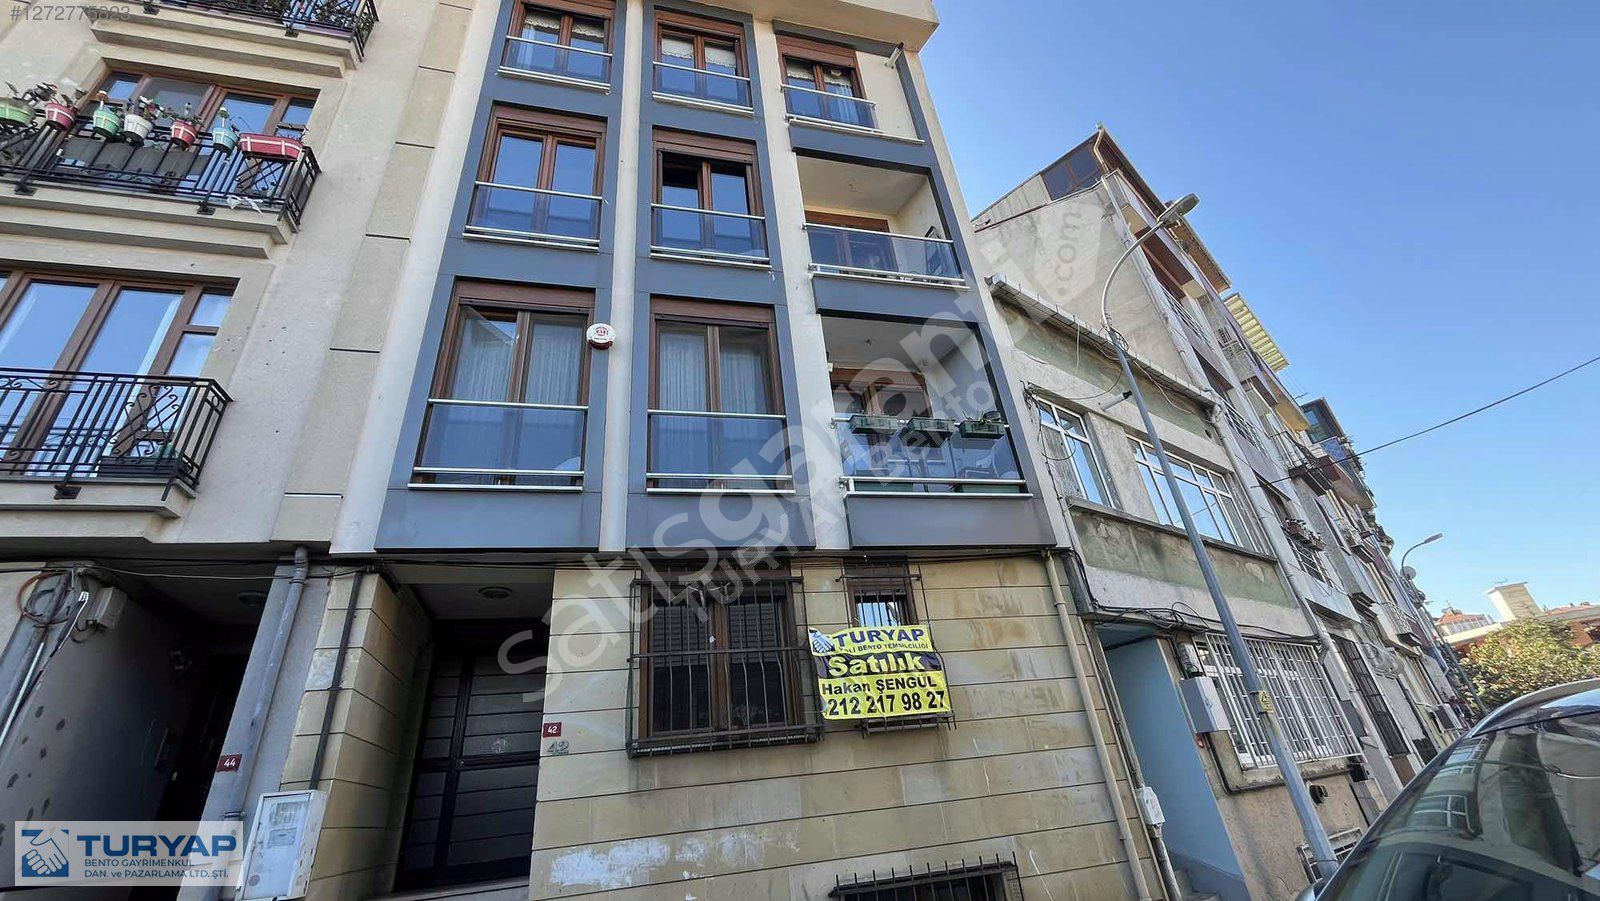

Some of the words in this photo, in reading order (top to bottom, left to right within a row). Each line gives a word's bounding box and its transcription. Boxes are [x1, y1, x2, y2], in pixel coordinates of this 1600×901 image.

[833, 628, 925, 648] TURYAP
[857, 643, 882, 652] BENTO
[828, 652, 926, 677] Satılık
[822, 682, 871, 696] Hakan
[876, 675, 937, 695] ŞENGÜL
[827, 696, 861, 716] 212
[866, 694, 896, 714] 217
[902, 692, 923, 711] 98
[926, 690, 945, 709] 27
[547, 725, 558, 734] 42
[547, 740, 570, 755] 42
[223, 758, 237, 767] 44
